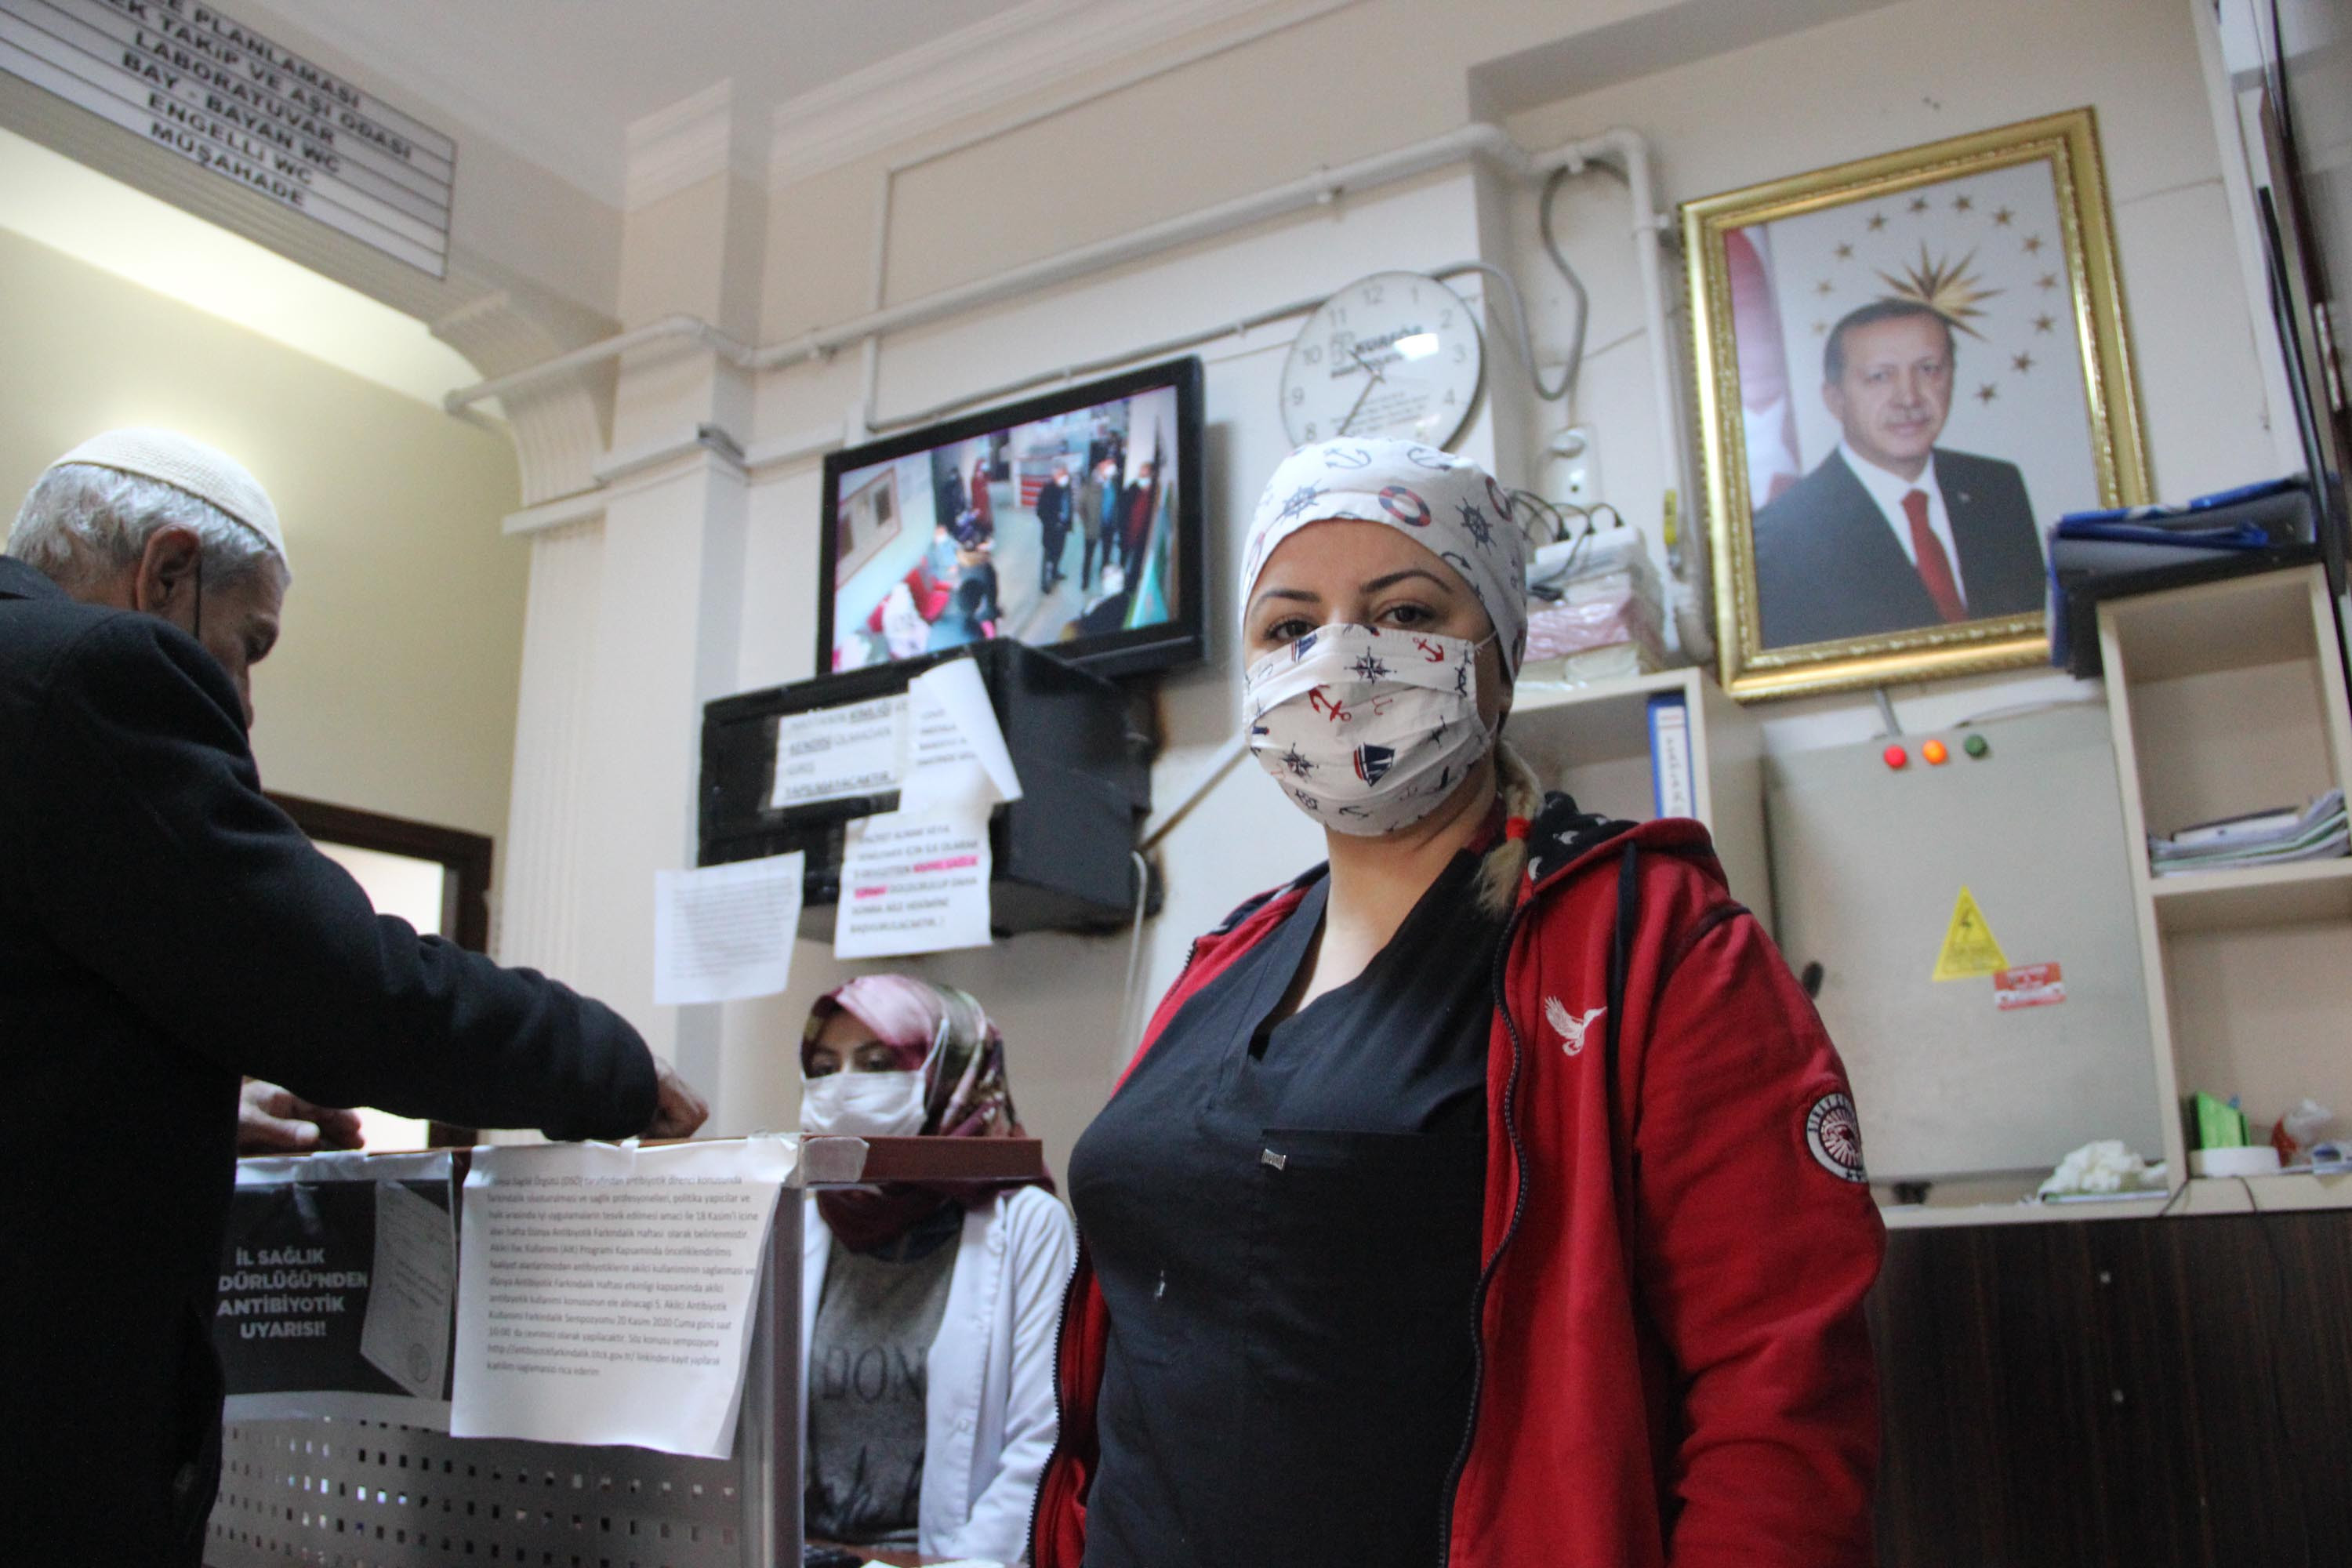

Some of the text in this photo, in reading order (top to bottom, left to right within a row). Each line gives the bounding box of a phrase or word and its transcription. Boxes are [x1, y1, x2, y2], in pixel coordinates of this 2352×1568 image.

[249, 61, 280, 91] VE
[136, 30, 336, 145] LABORATUVAR
[122, 50, 180, 90] BAY
[205, 94, 293, 150] BAYAN
[302, 144, 340, 173] WC
[274, 157, 313, 185] WC
[1363, 285, 1384, 305] 12
[1440, 309, 1452, 328] 2
[1303, 344, 1323, 365] 10
[1453, 343, 1466, 364] 3
[1293, 387, 1305, 405] 9
[1443, 387, 1456, 405] 4
[695, 1211, 706, 1220] 18
[257, 1245, 326, 1265] SAĞLIK
[216, 1294, 345, 1317] ANTİBİYOTİK
